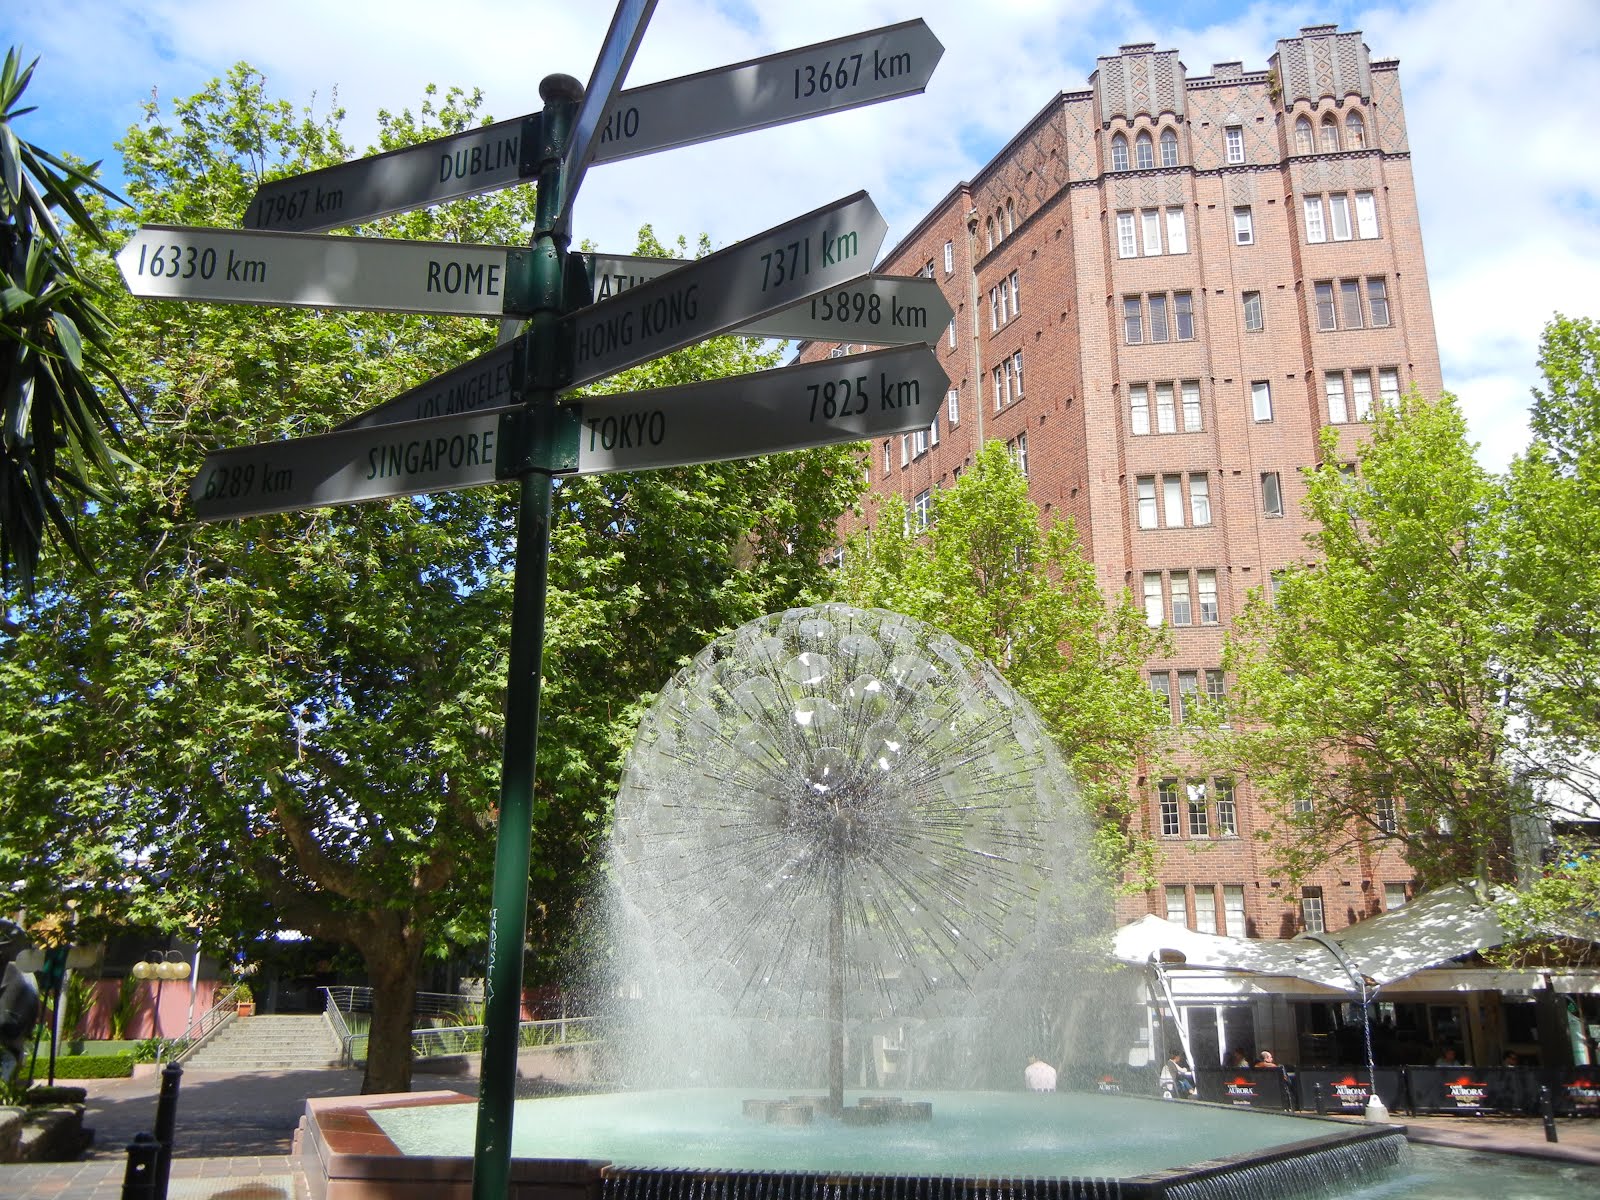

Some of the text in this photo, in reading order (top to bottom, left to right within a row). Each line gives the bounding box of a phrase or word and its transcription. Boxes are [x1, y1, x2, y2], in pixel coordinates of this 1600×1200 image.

[793, 54, 862, 99] 13667
[873, 50, 911, 81] km
[256, 136, 519, 228] 17967 km DUBLIN
[137, 244, 500, 296] 16330 km ROME
[578, 228, 858, 364] HONG KONG 7371 km
[811, 291, 881, 325] 15898
[891, 295, 927, 328] km
[446, 361, 513, 414] ANGELES
[587, 373, 920, 452] TOKYO 7825 km
[203, 431, 493, 501] 6289 km SINGAPORE
[1451, 1088, 1484, 1096] AURORA
